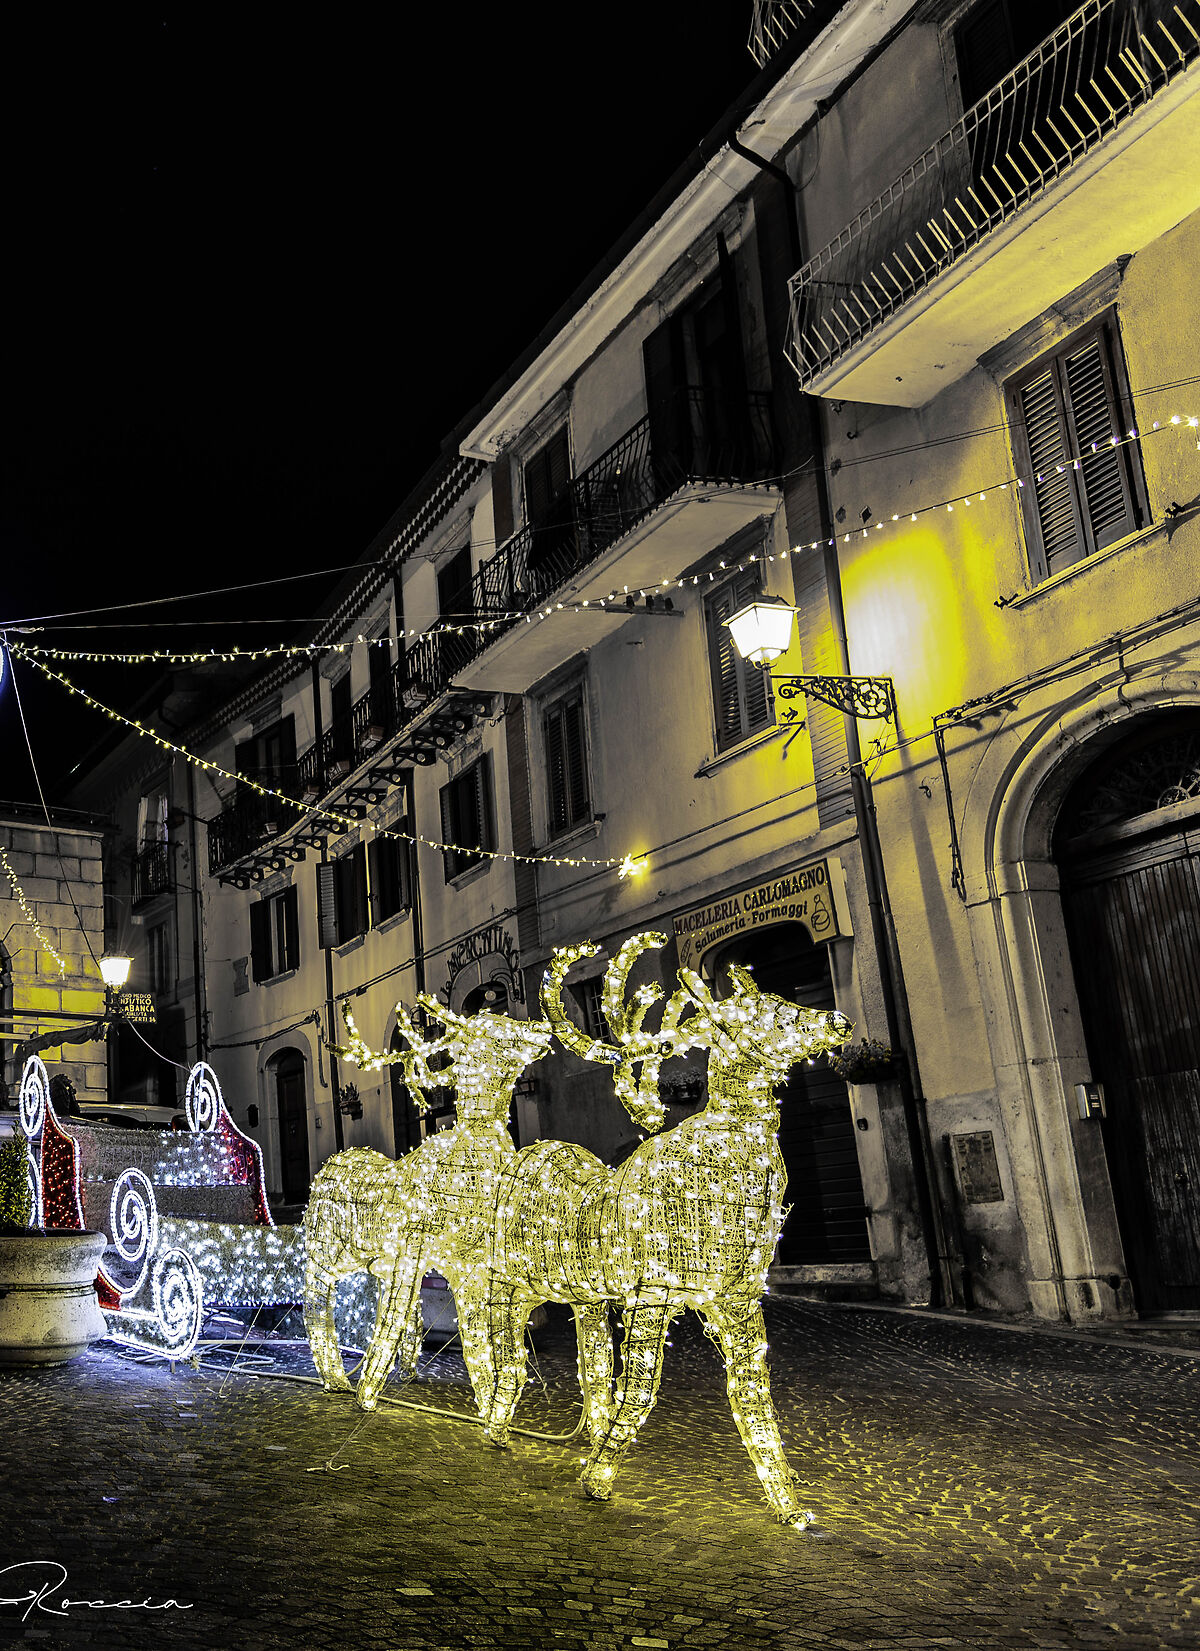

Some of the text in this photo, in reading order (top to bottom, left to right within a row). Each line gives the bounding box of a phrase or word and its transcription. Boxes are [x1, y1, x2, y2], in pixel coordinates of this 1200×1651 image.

[674, 866, 825, 936] MACELLERIA CARLOMAGNO
[695, 917, 746, 953] Salumeria
[752, 900, 808, 924] Formaggi
